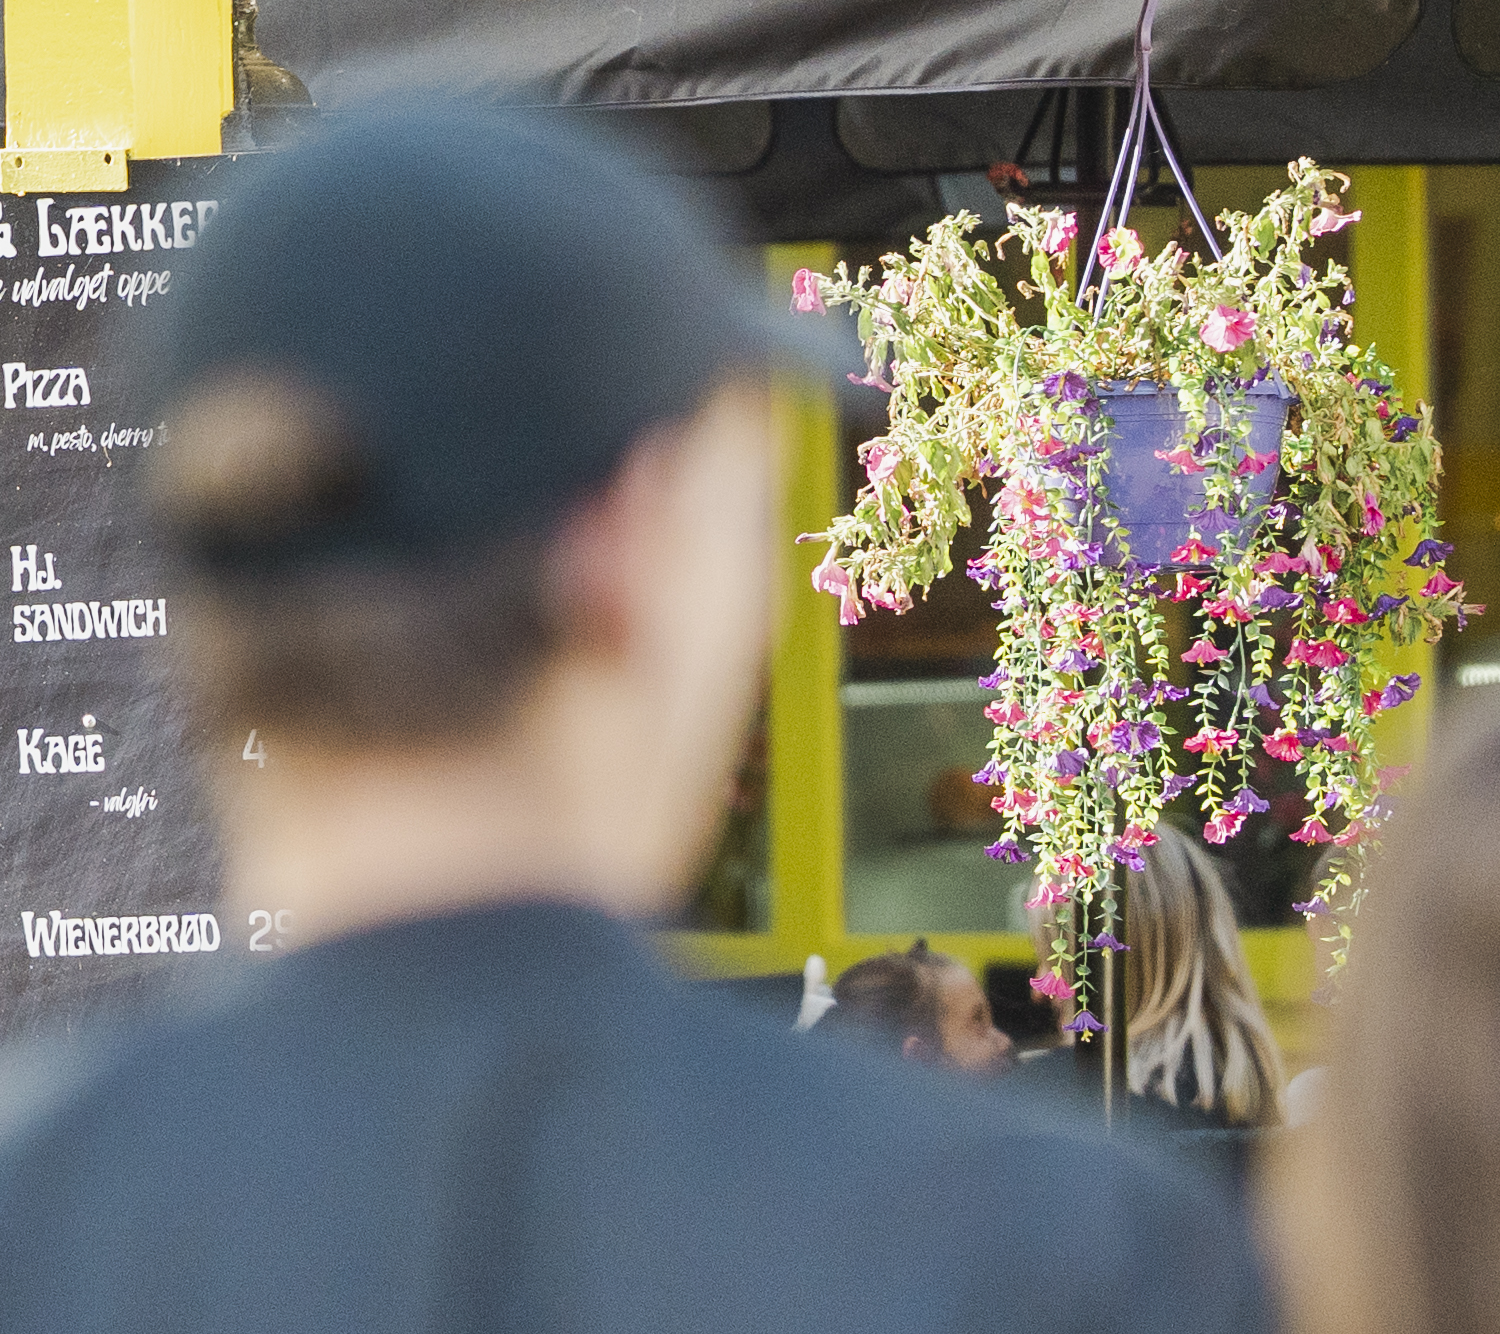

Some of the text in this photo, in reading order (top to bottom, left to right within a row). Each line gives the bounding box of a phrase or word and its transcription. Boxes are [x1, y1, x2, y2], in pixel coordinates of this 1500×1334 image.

[11, 263, 114, 311] udvalget
[2, 362, 91, 409] PIZZA
[50, 424, 97, 457] pesto,
[100, 422, 154, 449] cherry
[13, 598, 167, 643] SANDWICH
[17, 728, 105, 774] KAGE
[103, 786, 159, 818] valgfri
[21, 910, 221, 957] WIENERBRØD
